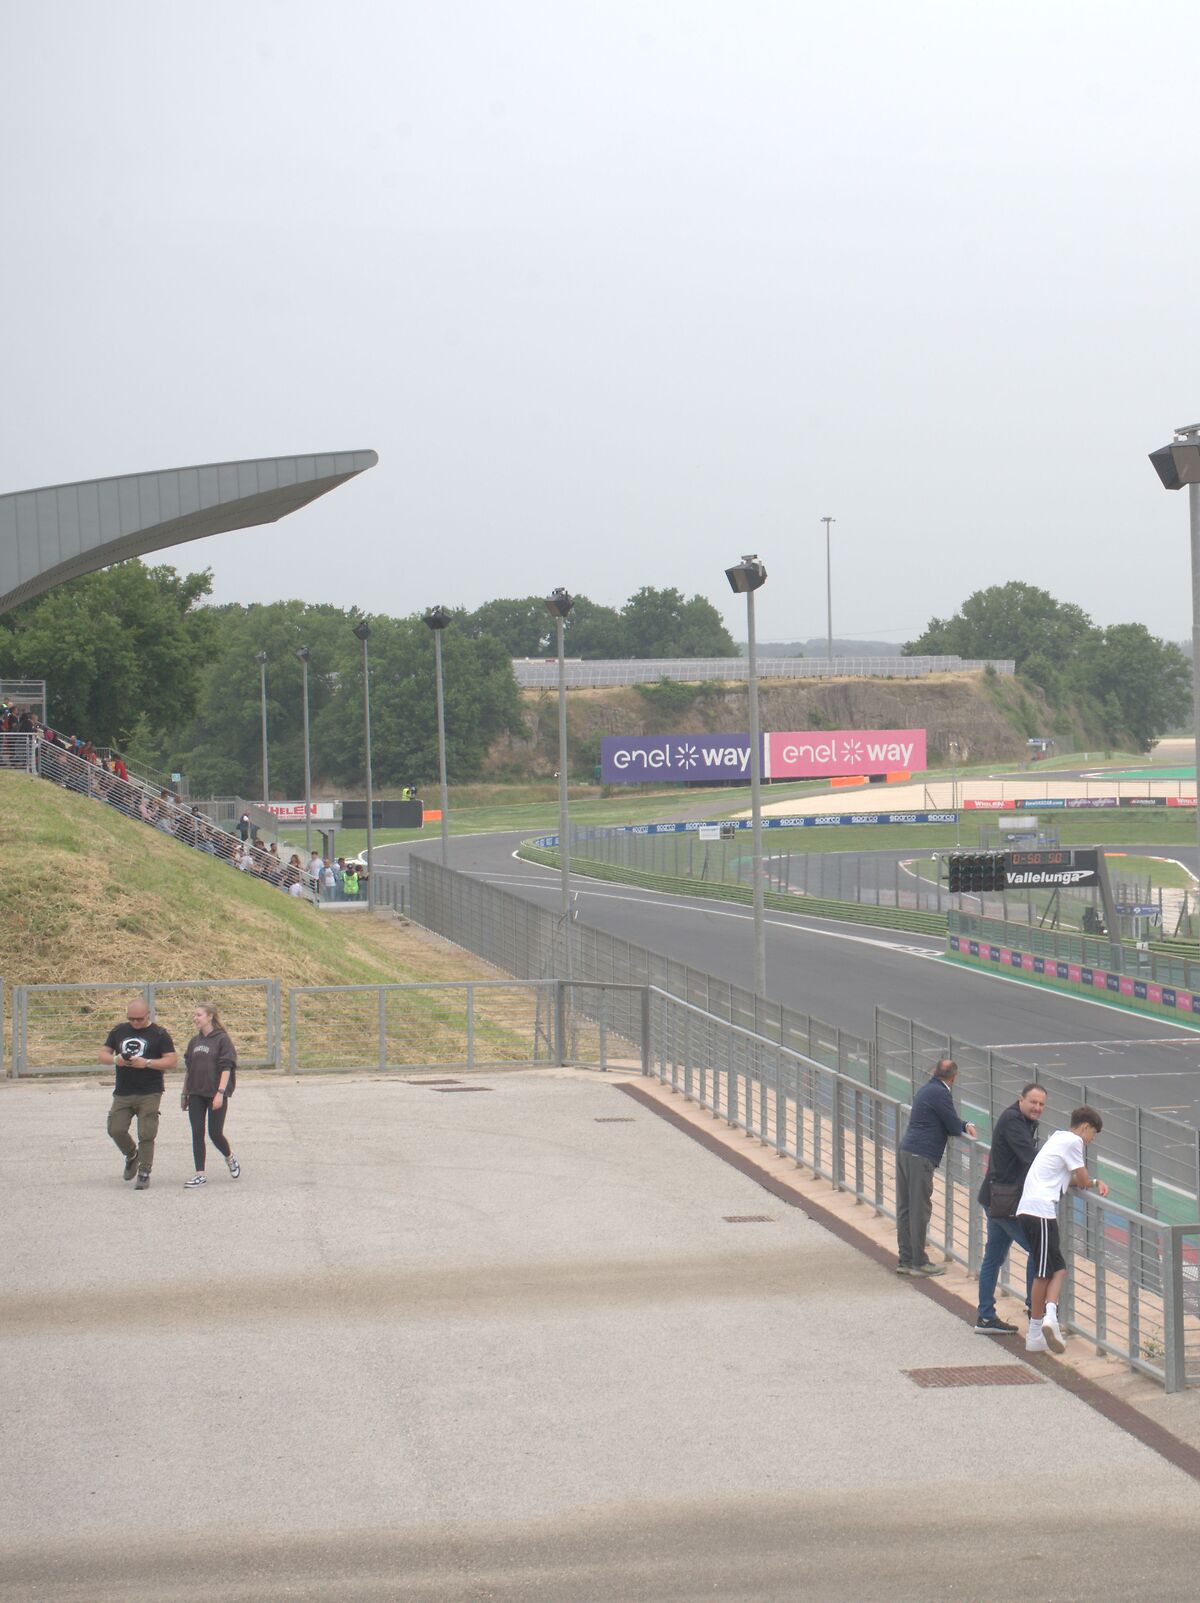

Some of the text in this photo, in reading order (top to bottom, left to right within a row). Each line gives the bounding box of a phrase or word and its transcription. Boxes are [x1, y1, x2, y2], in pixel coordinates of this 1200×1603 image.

[614, 743, 751, 772] enel way
[783, 739, 913, 767] enel way
[656, 824, 676, 832] sparco
[1006, 871, 1080, 884] Vallelunga
